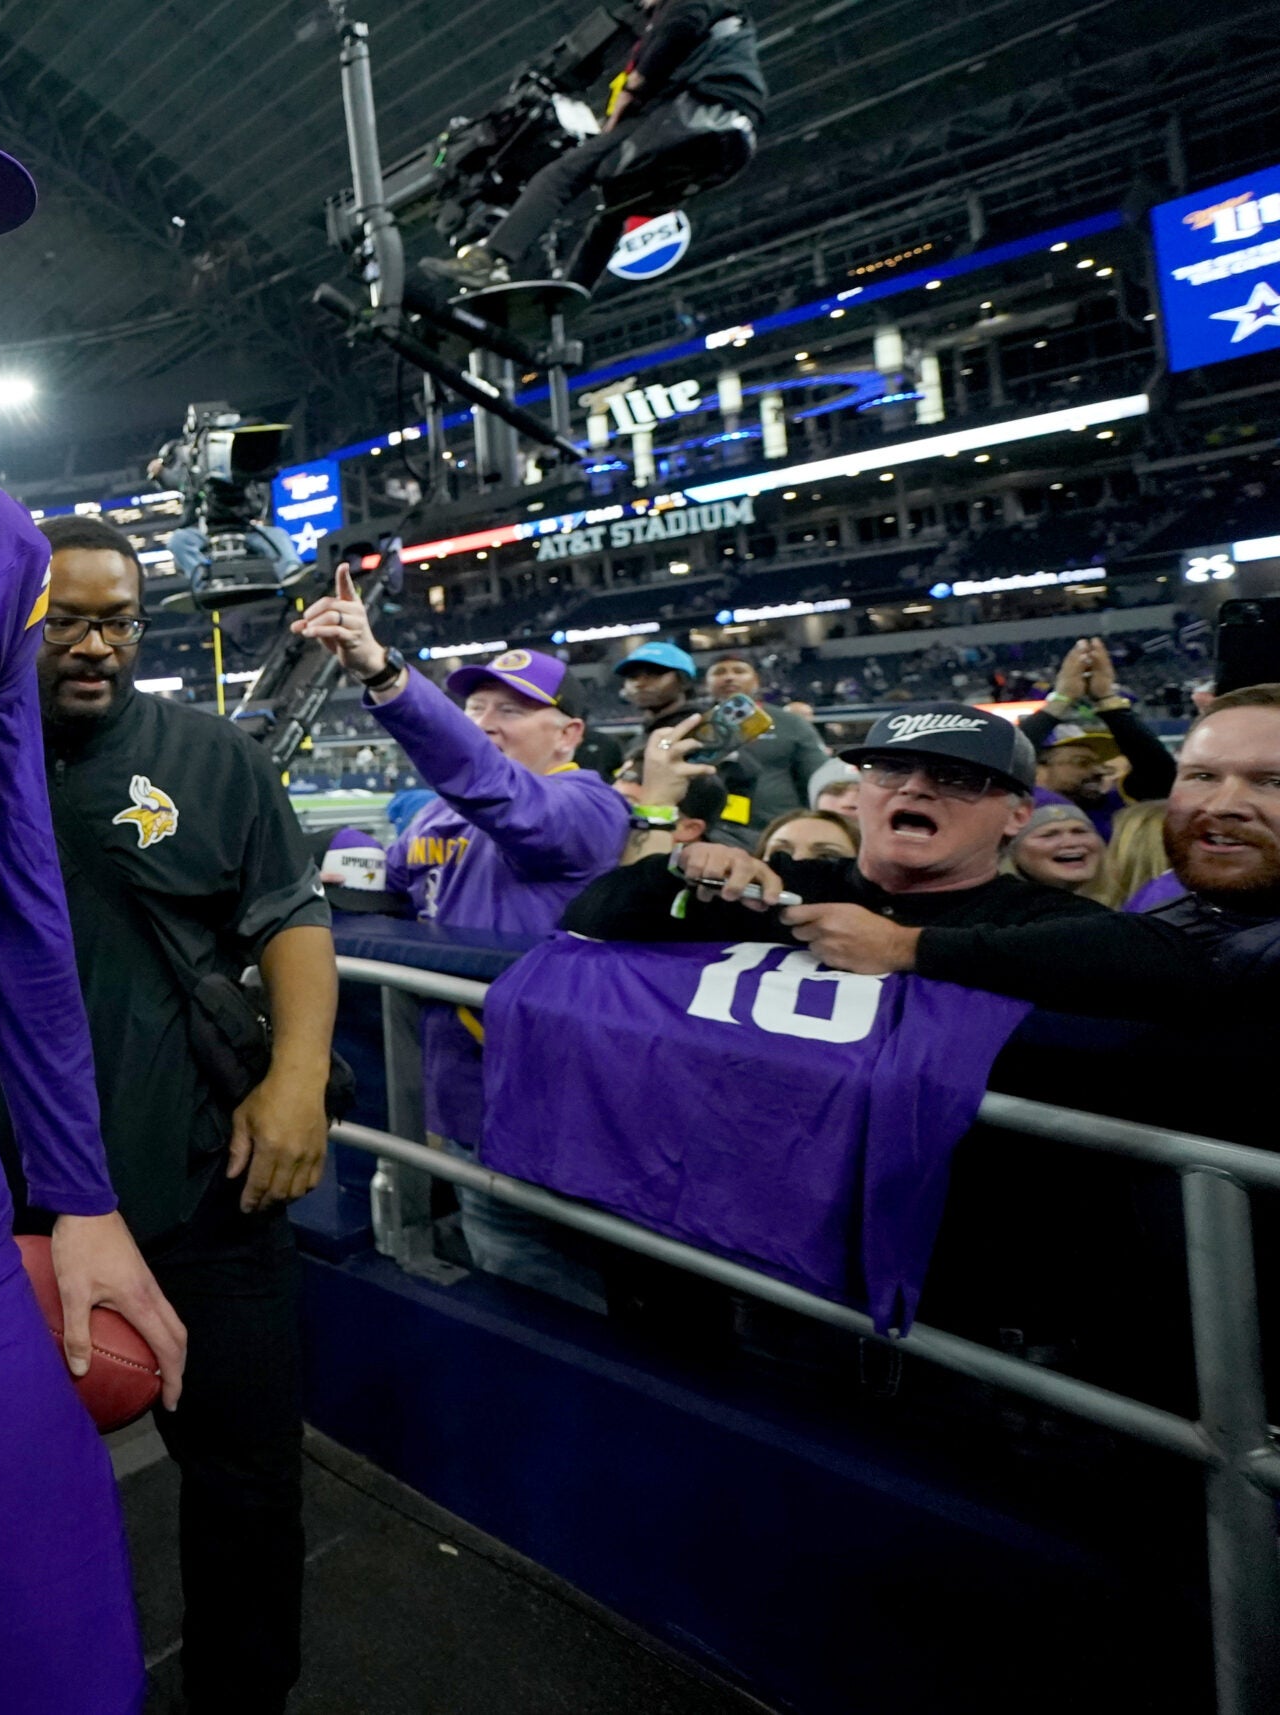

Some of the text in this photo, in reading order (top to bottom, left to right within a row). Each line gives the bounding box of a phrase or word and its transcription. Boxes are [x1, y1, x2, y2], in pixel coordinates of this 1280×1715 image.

[617, 215, 684, 253] EPSI
[605, 379, 702, 435] Lite
[536, 525, 608, 562] AT&T
[610, 497, 756, 549] STADIUM
[887, 713, 989, 741] Miller
